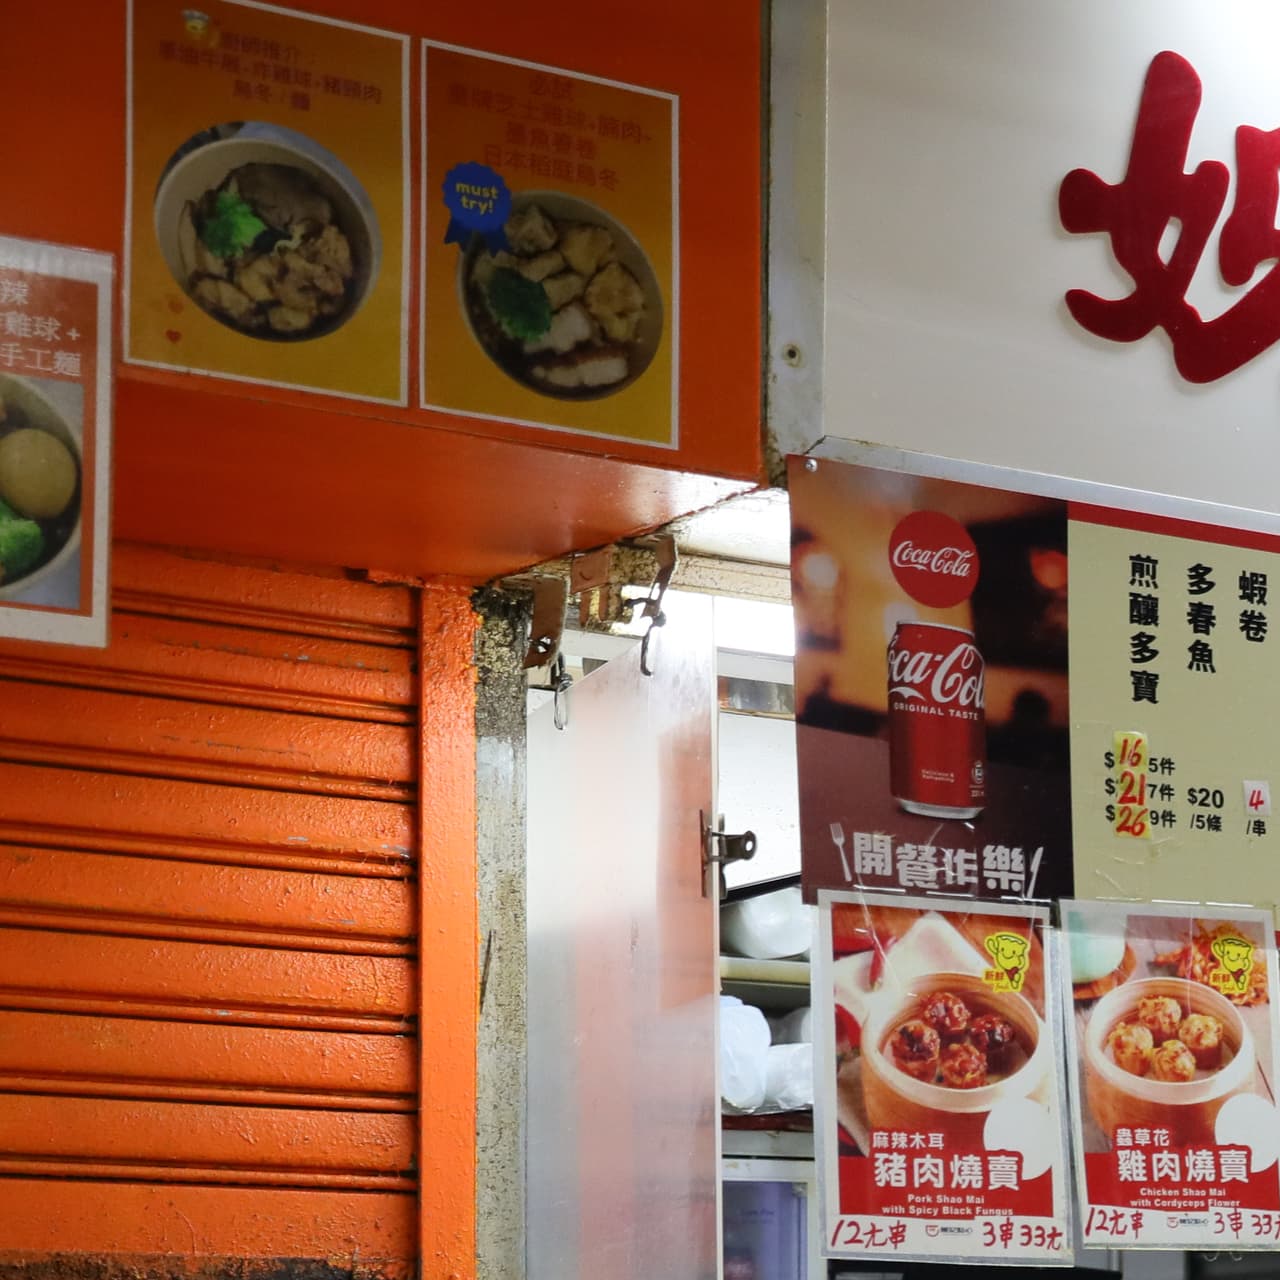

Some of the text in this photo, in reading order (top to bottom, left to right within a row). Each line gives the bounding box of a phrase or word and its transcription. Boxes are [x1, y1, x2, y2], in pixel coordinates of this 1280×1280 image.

[455, 183, 499, 199] must
[461, 196, 494, 216] try!
[893, 540, 974, 577] Coca-Cola
[1238, 571, 1268, 643] 蝦卷
[1129, 554, 1159, 704] 煎釀多寶
[1187, 563, 1216, 674] 多春魚
[894, 703, 979, 720] ORIGINAL TASTE
[1120, 739, 1175, 775] 16 5件
[1117, 771, 1175, 806] 21 7件
[1187, 788, 1224, 809] $20
[1249, 790, 1264, 809] 4
[1116, 806, 1176, 836] 26 9件
[852, 831, 1025, 891] 開餐作樂
[872, 1132, 944, 1149] 麻辣木耳
[1116, 1128, 1169, 1147] 蟲草花
[874, 1153, 1020, 1190] 豬肉燒賣
[1117, 1149, 1249, 1183] 雞肉燒賣
[908, 1194, 985, 1204] Pork Shao Mai
[1140, 1188, 1226, 1197] Chicken Shao Mai
[882, 1206, 1013, 1216] with Spicy Black Fungus
[1130, 1199, 1240, 1209] with Cordyceps Flower
